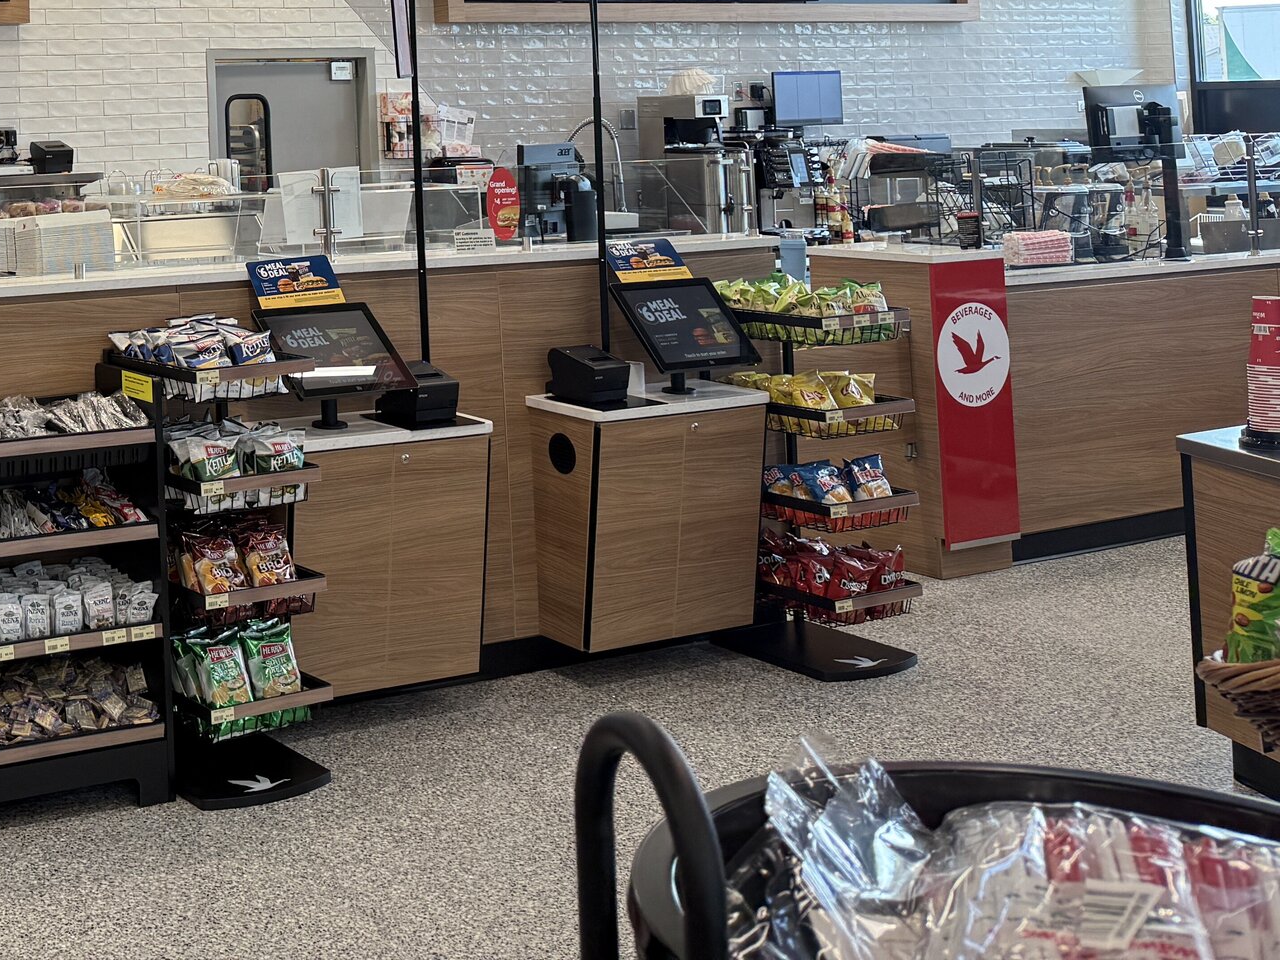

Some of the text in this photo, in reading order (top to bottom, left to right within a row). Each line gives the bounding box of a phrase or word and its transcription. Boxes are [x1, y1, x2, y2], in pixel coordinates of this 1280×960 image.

[619, 248, 638, 256] DEAL
[265, 261, 286, 270] MEAL
[268, 267, 288, 278] DEAL
[647, 298, 679, 311] MEAL
[654, 309, 687, 323] DEAL
[951, 306, 992, 325] BEVERAGES
[291, 327, 323, 338] MEAL
[297, 336, 330, 348] DEAL
[959, 387, 995, 403] AND MORE
[270, 452, 298, 471] KETTLE
[258, 557, 285, 572] BBQ
